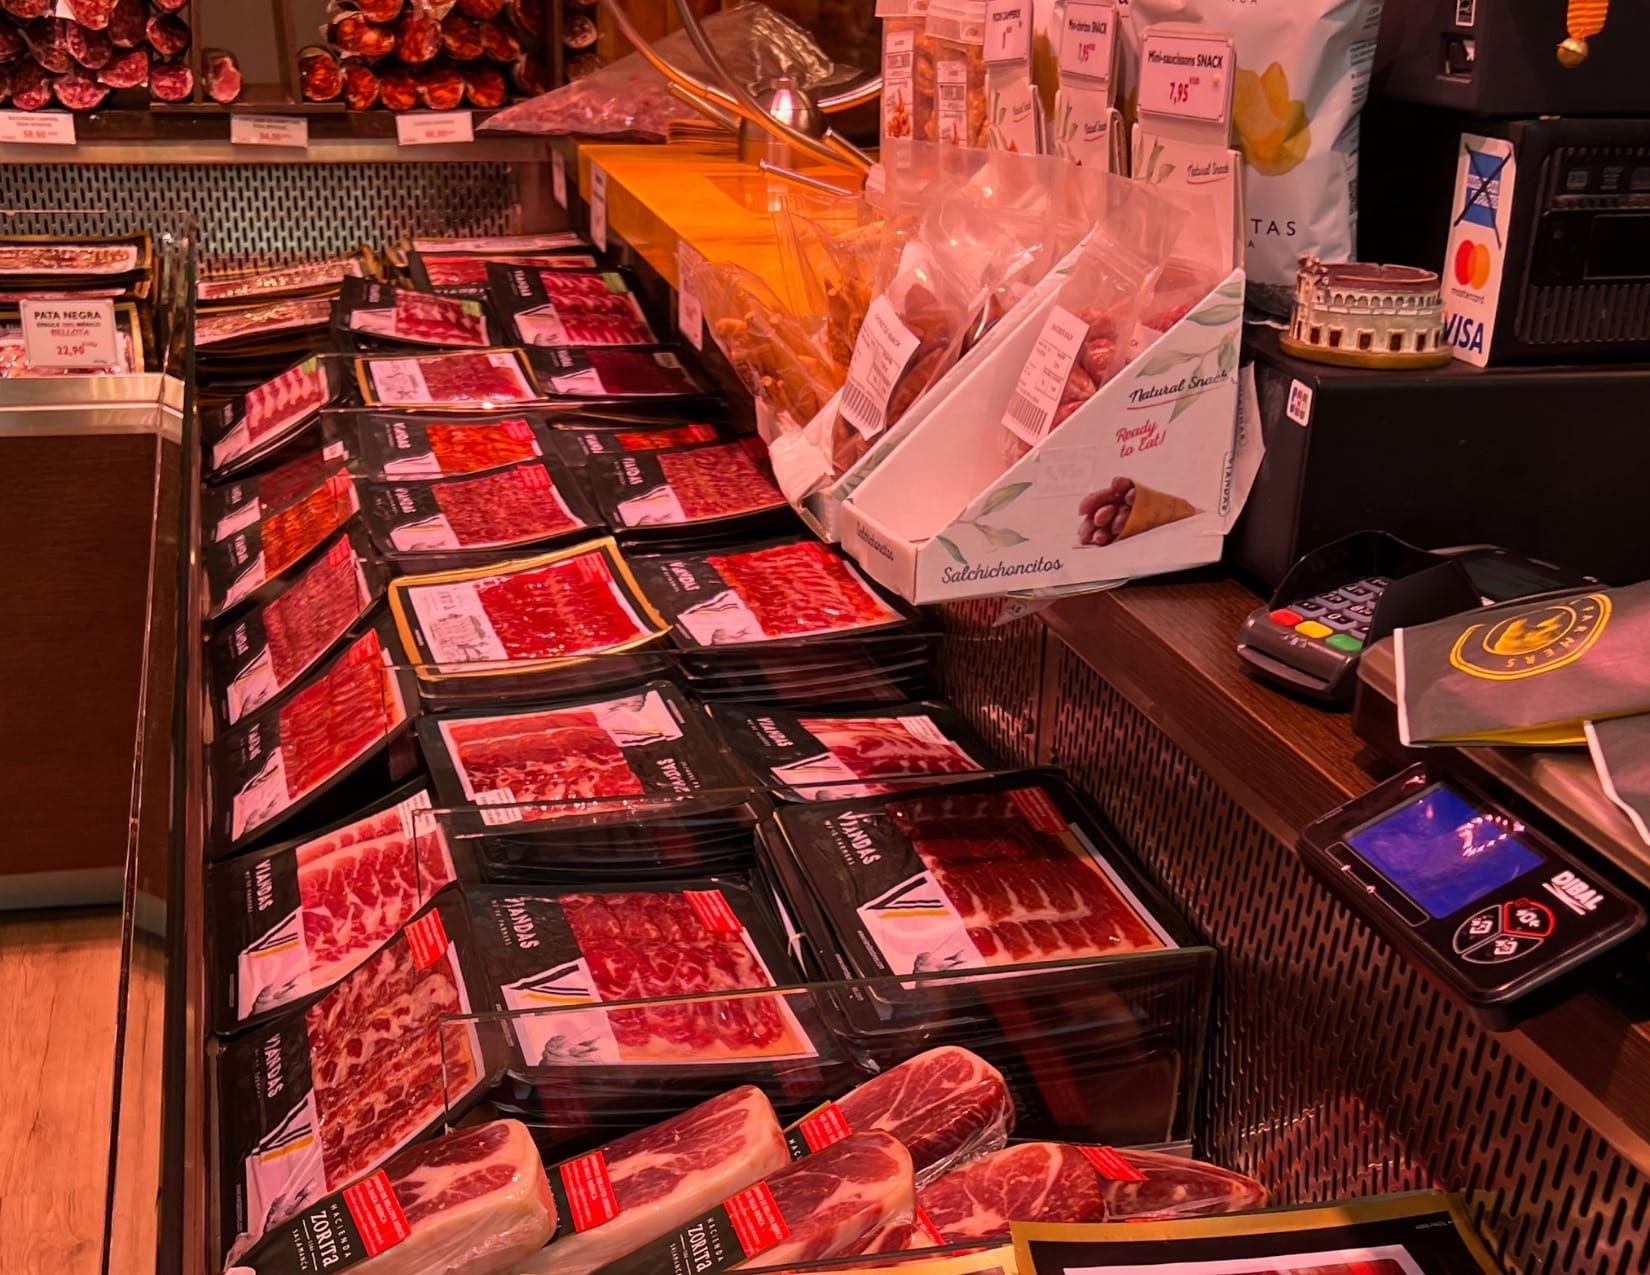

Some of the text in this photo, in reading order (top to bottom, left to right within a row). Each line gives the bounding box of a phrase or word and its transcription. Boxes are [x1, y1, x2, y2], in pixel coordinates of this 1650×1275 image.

[1148, 50, 1223, 69] Mini-saucissons SNACK
[1169, 81, 1189, 104] 7,95
[34, 311, 101, 320] PATA NEGRA
[51, 329, 90, 337] BELLOTA
[1442, 313, 1485, 354] VISA
[57, 345, 85, 356] 22,90
[1129, 369, 1228, 403] Natural Snack
[1115, 419, 1158, 443] Ready
[1119, 430, 1167, 458] to Eat!
[941, 555, 1065, 584] Salchichoncitos
[1505, 604, 1595, 668] FARMERS
[756, 716, 794, 747] VIANDAS
[837, 810, 881, 866] VIANDAS
[255, 859, 273, 912] VIANDAS
[1551, 870, 1605, 911] DIBAL
[504, 897, 541, 950] VIANDAS
[264, 1032, 284, 1098] VIANDAS
[330, 1203, 352, 1258] HACIENDA
[707, 1216, 725, 1262] HACIENDA
[291, 1228, 309, 1271] SALAMANCA
